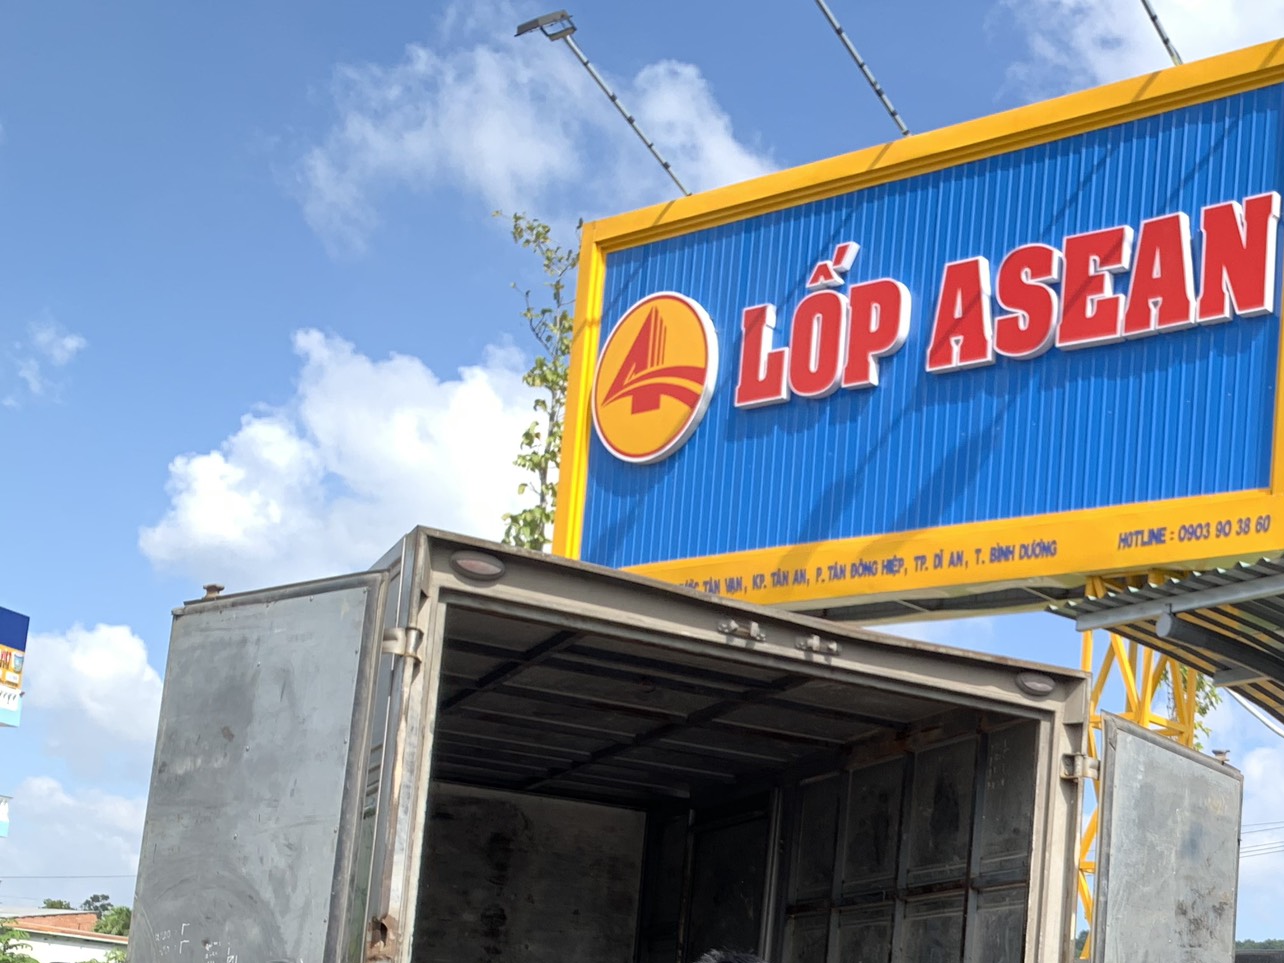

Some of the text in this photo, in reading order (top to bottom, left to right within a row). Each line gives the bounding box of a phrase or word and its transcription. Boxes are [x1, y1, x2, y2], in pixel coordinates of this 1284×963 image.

[735, 191, 1281, 409] LỐP ASEAN
[1117, 526, 1167, 550] HOTLINE
[1178, 522, 1210, 543] 0903
[1215, 519, 1232, 539] 90
[1236, 516, 1250, 536] 38
[1255, 514, 1271, 533] 60
[752, 573, 767, 590] KP.
[771, 568, 789, 587] TÂN
[828, 561, 846, 581] TÂN
[914, 555, 928, 572] TP.
[989, 542, 1015, 563] BÌNH
